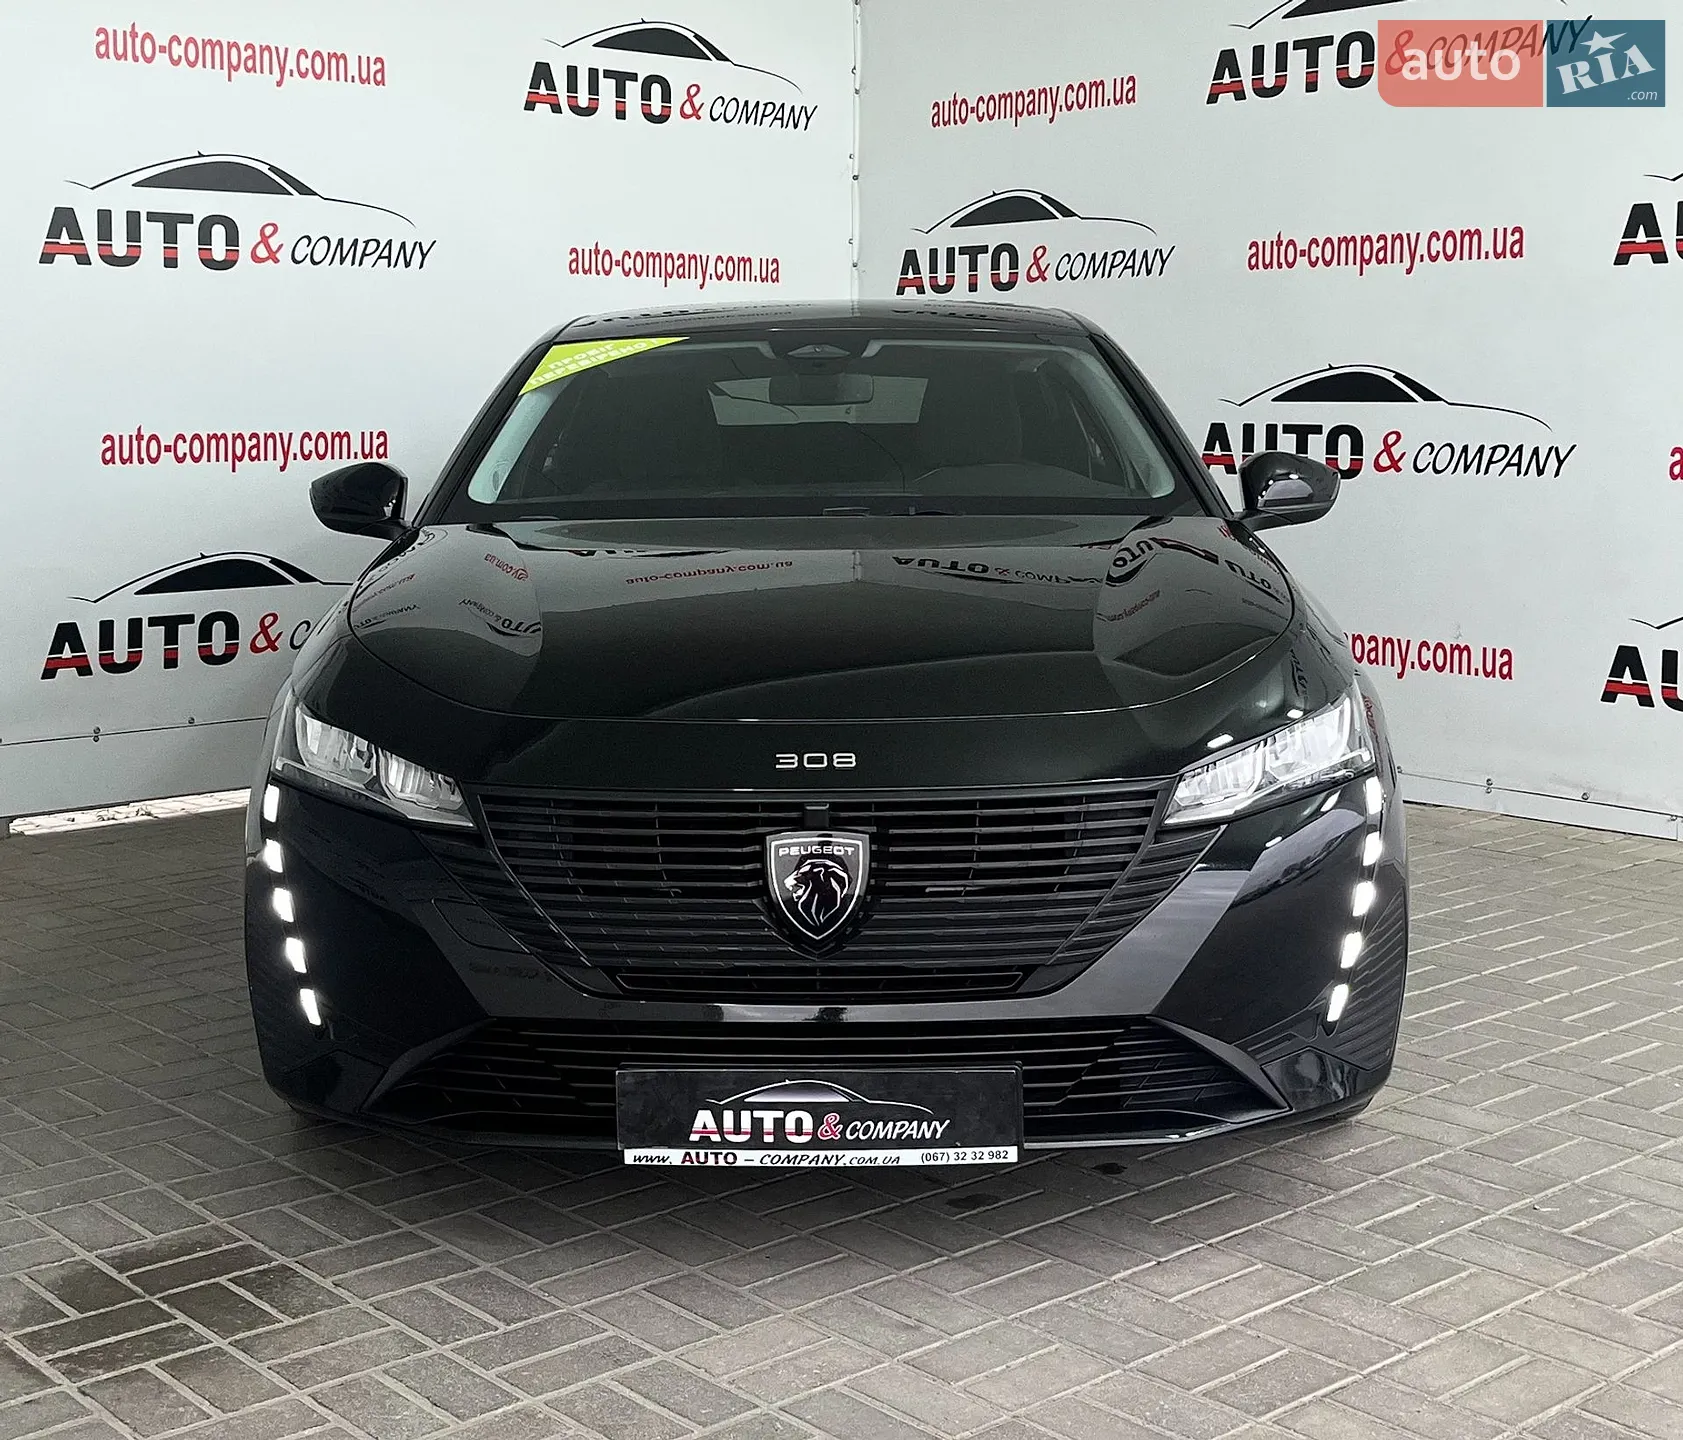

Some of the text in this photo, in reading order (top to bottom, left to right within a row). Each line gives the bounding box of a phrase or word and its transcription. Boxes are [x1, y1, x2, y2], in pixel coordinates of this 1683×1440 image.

[96, 22, 386, 87] auto-company.com.ua
[1206, 31, 1375, 104] AUTO
[524, 62, 818, 132] AUTO & COMPANY
[932, 76, 1136, 128] auto-company.com.ua
[39, 207, 437, 271] AUTO & COMPANY
[1248, 226, 1524, 276] auto-company.com.ua
[569, 241, 780, 290] auto-company.com.ua
[896, 243, 1176, 296] AUTO & COMPANY
[101, 424, 389, 473] auto-company.com.ua
[1373, 431, 1407, 474] &
[1413, 442, 1577, 478] COMPANY
[41, 610, 240, 680] AUTO
[250, 612, 284, 654] &
[775, 752, 857, 769] 308
[778, 845, 855, 857] PEUGEOT
[689, 1109, 950, 1144] AUTO & COMPANY
[633, 1154, 672, 1165] www.
[681, 1151, 738, 1165] AUTO
[921, 1151, 950, 1164] (067)
[953, 1151, 967, 1161] 32
[971, 1151, 984, 1161] 32
[988, 1150, 1008, 1160] 982
